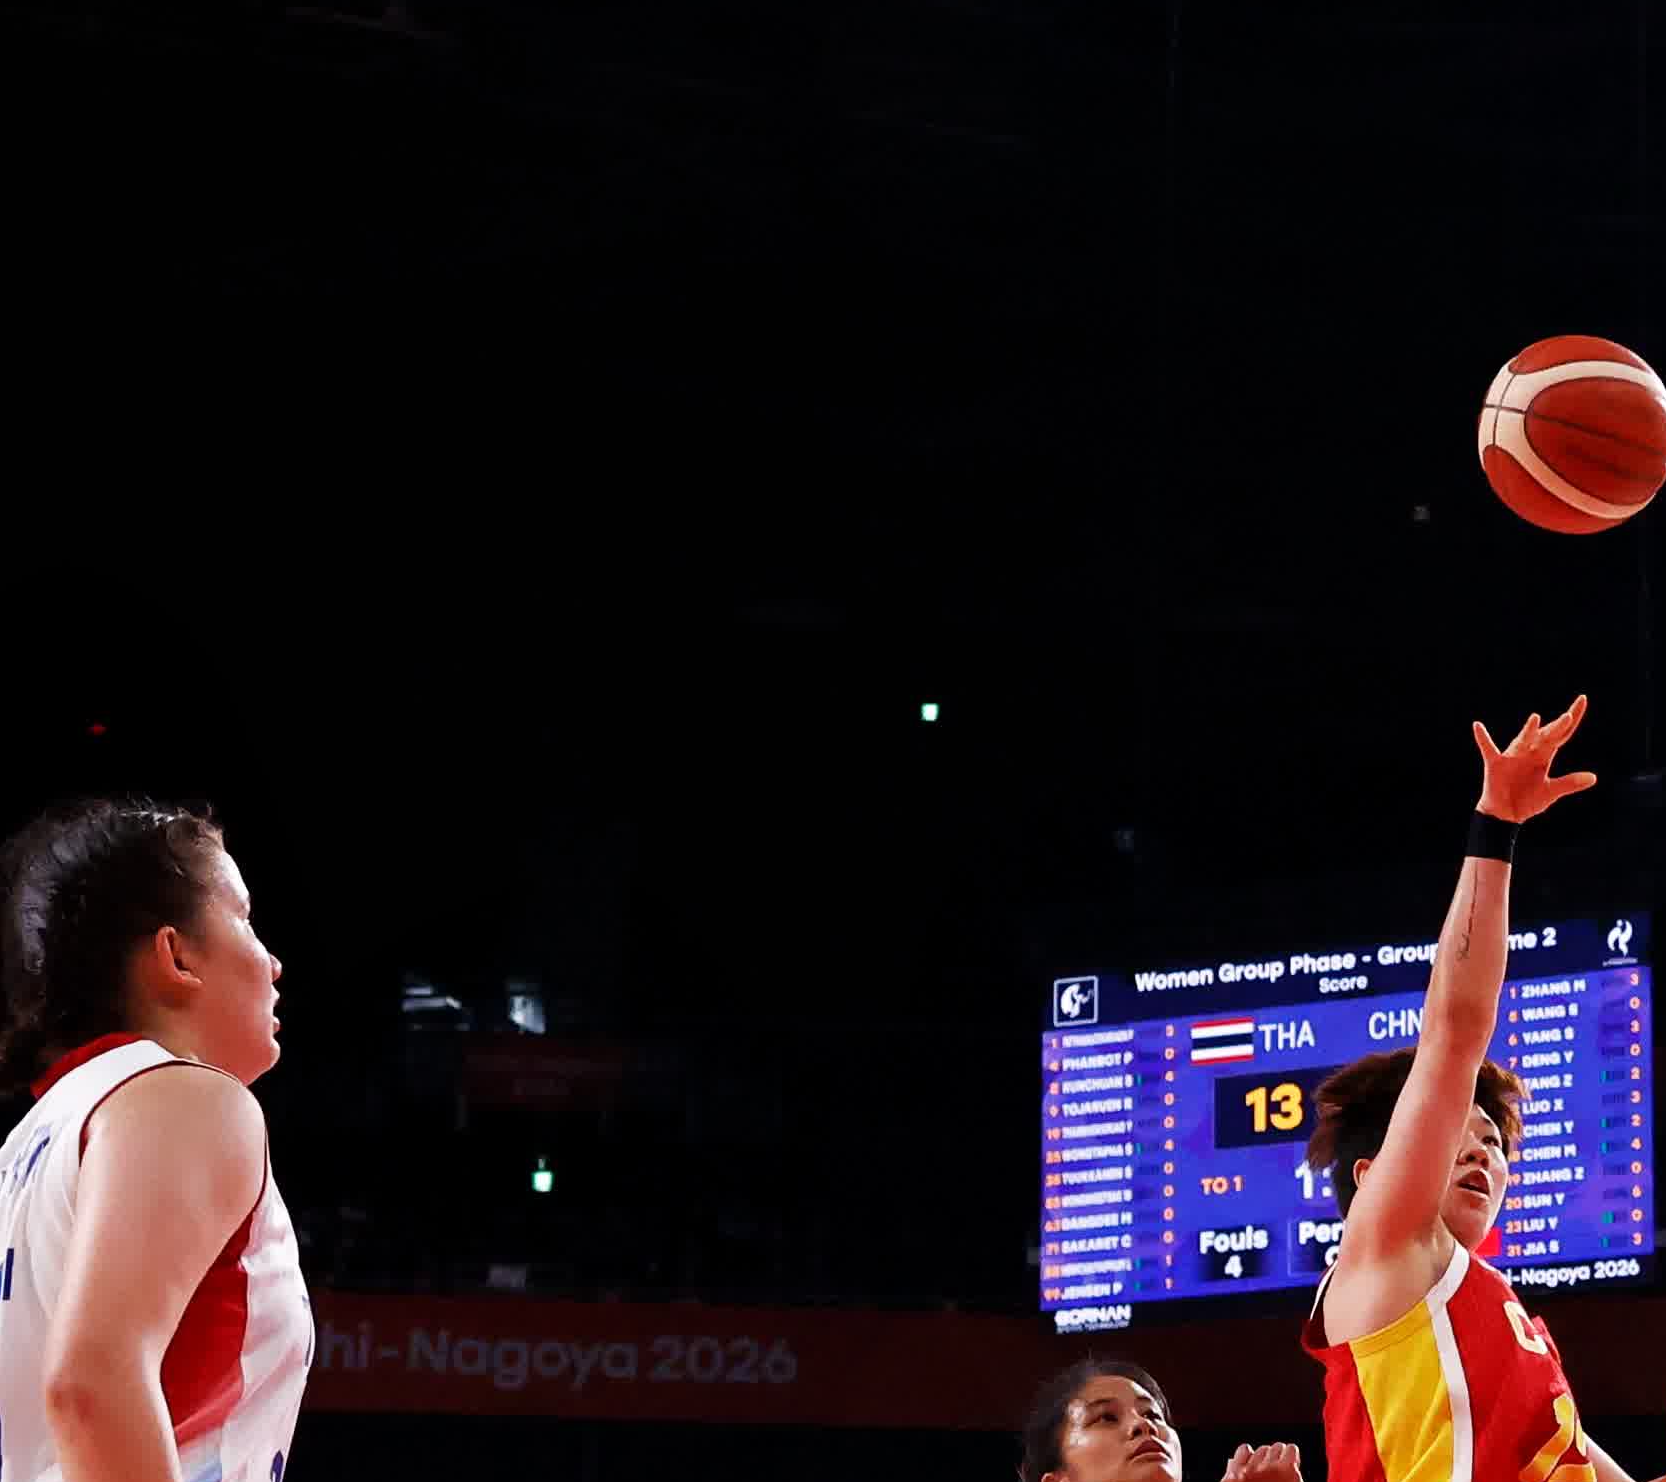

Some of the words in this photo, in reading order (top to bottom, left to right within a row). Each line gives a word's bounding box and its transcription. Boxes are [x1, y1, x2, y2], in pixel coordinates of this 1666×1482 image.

[1135, 969, 1213, 992] Women
[1218, 959, 1285, 983] Group
[1290, 952, 1355, 974] Phase
[1507, 932, 1538, 951] me
[1541, 926, 1558, 948] 2
[1318, 975, 1369, 995] Score
[1521, 981, 1571, 999] ZHANG
[1368, 1008, 1424, 1040] CHN
[1521, 1004, 1566, 1022] WANG
[1257, 1020, 1316, 1053] THA
[1244, 1082, 1304, 1133] 13
[1522, 1122, 1562, 1139] CHEN
[1522, 1145, 1562, 1162] CHEN
[1200, 1176, 1230, 1195] TO
[1233, 1174, 1244, 1192] 1
[1294, 1160, 1335, 1200] 1:
[1521, 1168, 1572, 1186] ZHANG
[1198, 1224, 1269, 1255] Fouls
[1298, 1220, 1344, 1246] Per
[1224, 1254, 1244, 1279] 4
[1504, 1264, 1591, 1288] i-Nagoya
[1593, 1258, 1641, 1280] 2026
[315, 1321, 638, 1391] hi-Nagoya
[650, 1334, 799, 1386] 2026
